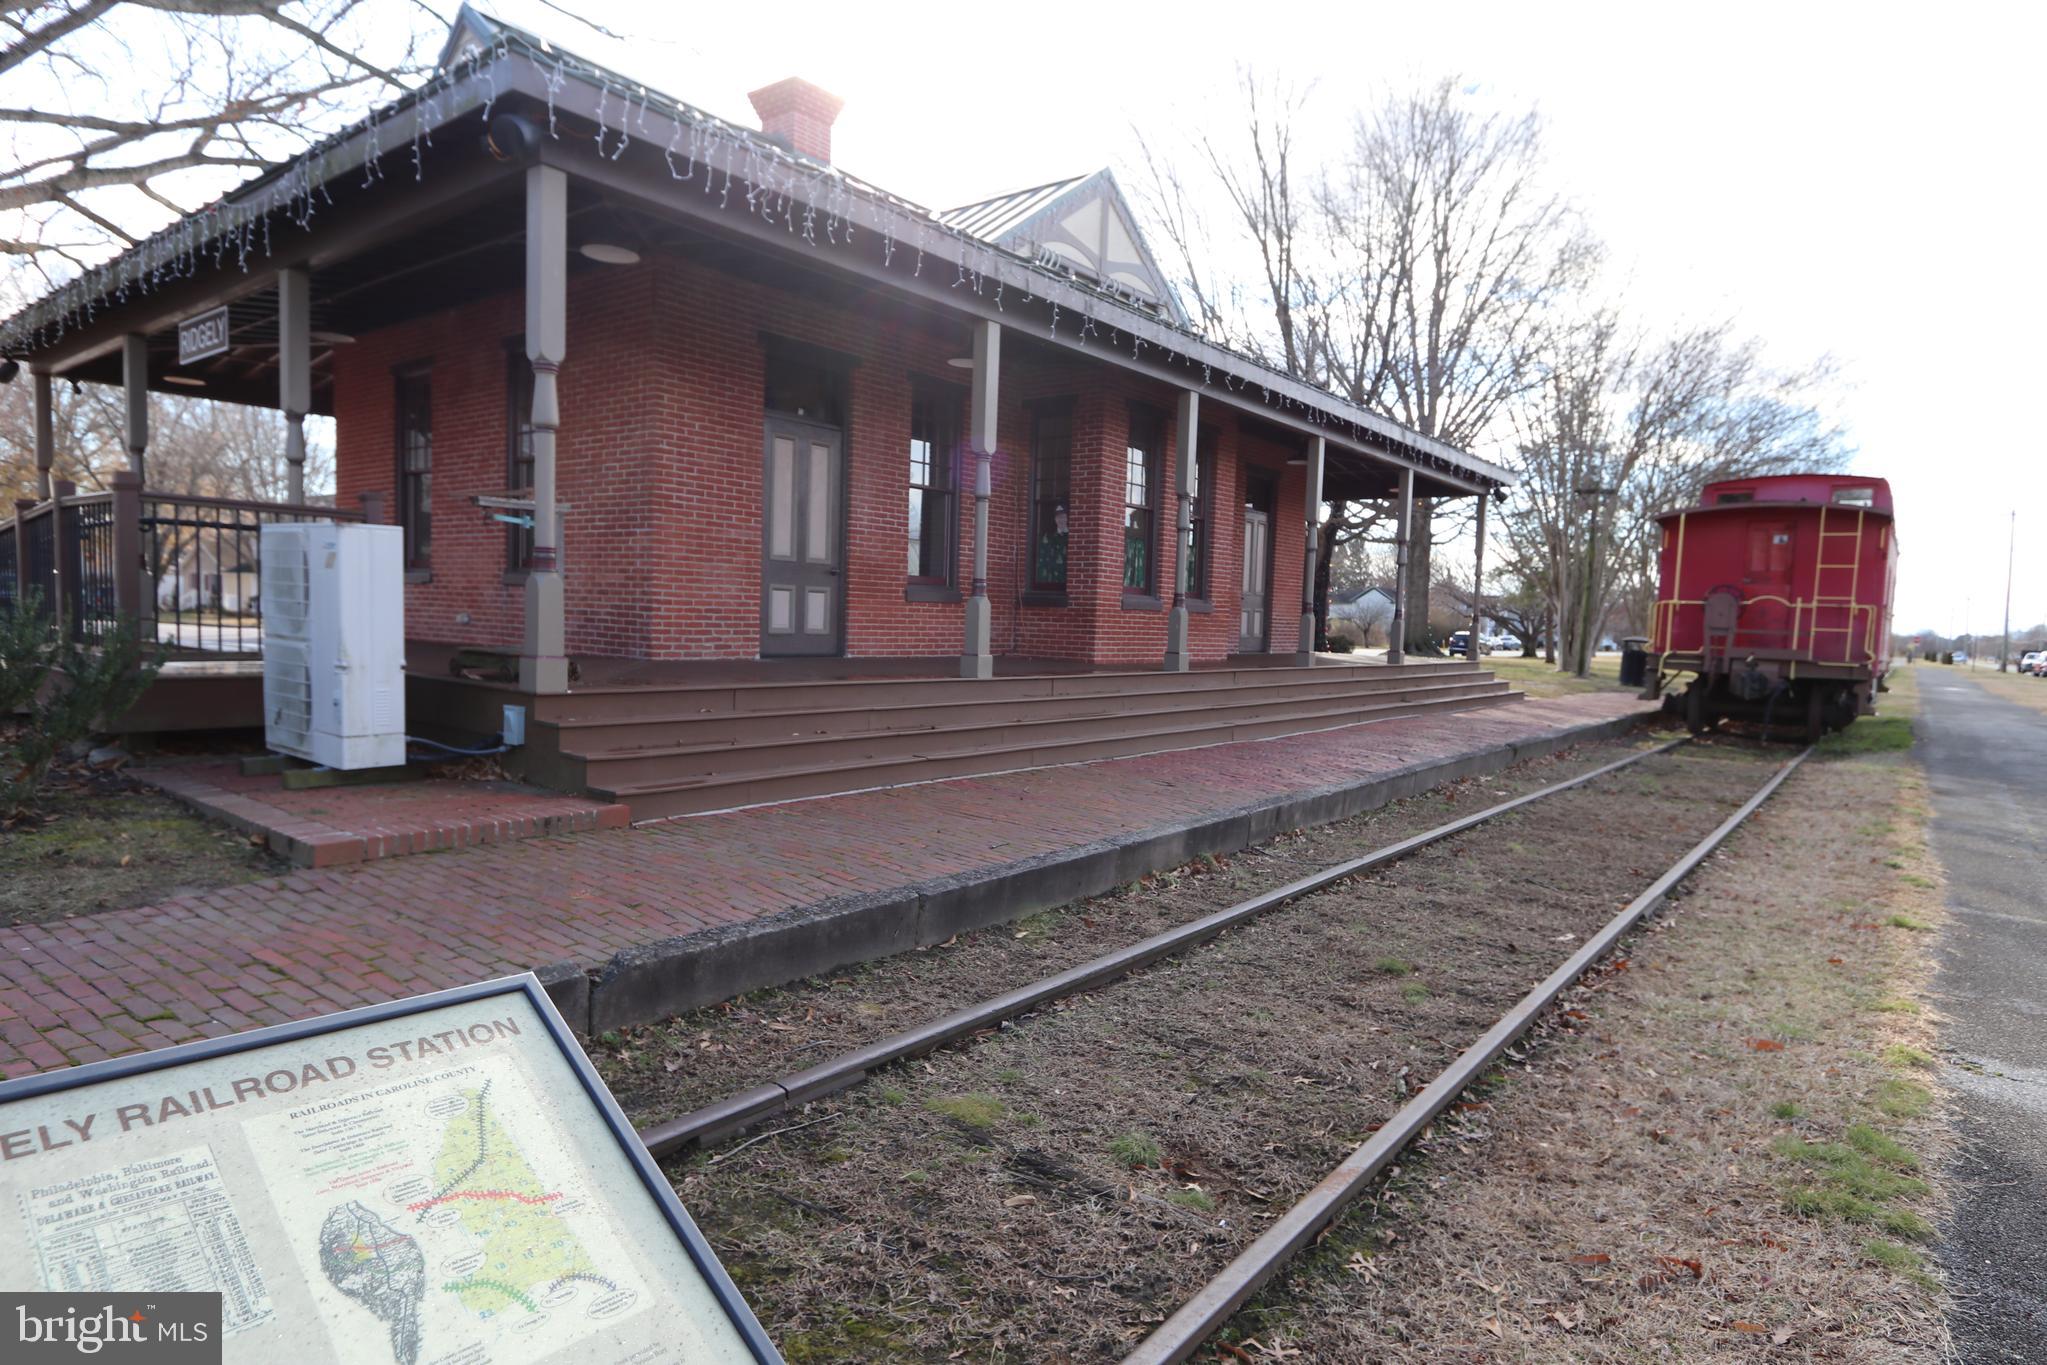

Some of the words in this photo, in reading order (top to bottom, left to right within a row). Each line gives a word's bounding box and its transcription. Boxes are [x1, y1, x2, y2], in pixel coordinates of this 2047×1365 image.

[181, 316, 225, 355] RIDGELY
[116, 1056, 357, 1132] RAILROAD
[366, 1017, 521, 1069] STATION
[290, 1095, 359, 1120] RAILROADS
[361, 1091, 374, 1101] IN
[375, 1077, 433, 1098] CAROLINE
[435, 1065, 477, 1080] COUNTY
[121, 1157, 182, 1177] Baltimore
[37, 1203, 96, 1226] DELAWARE
[111, 1183, 172, 1206] CHESAPEAKE
[48, 1193, 74, 1208] and
[79, 1175, 157, 1199] Washington
